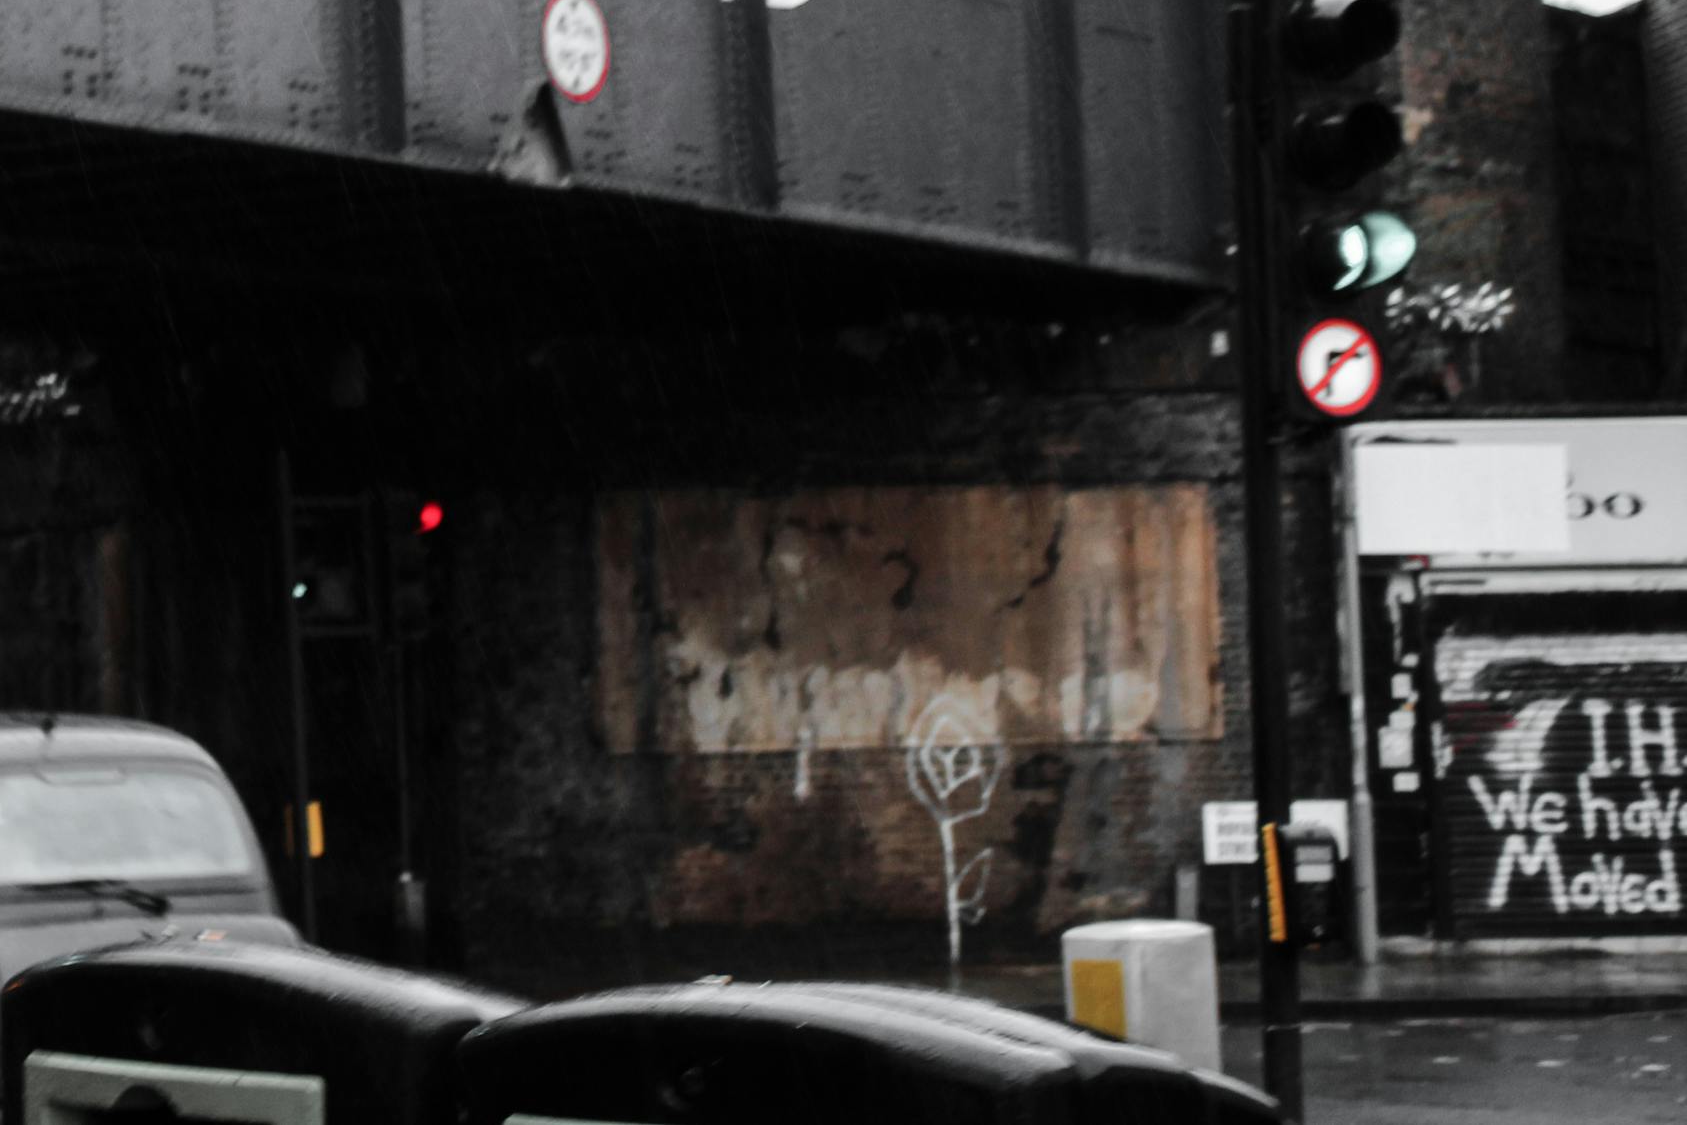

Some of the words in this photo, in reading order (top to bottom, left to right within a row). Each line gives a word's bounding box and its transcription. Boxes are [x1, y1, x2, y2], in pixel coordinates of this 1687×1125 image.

[1468, 774, 1568, 833] We
[1578, 773, 1687, 841] hav
[1488, 833, 1682, 914] Moved
